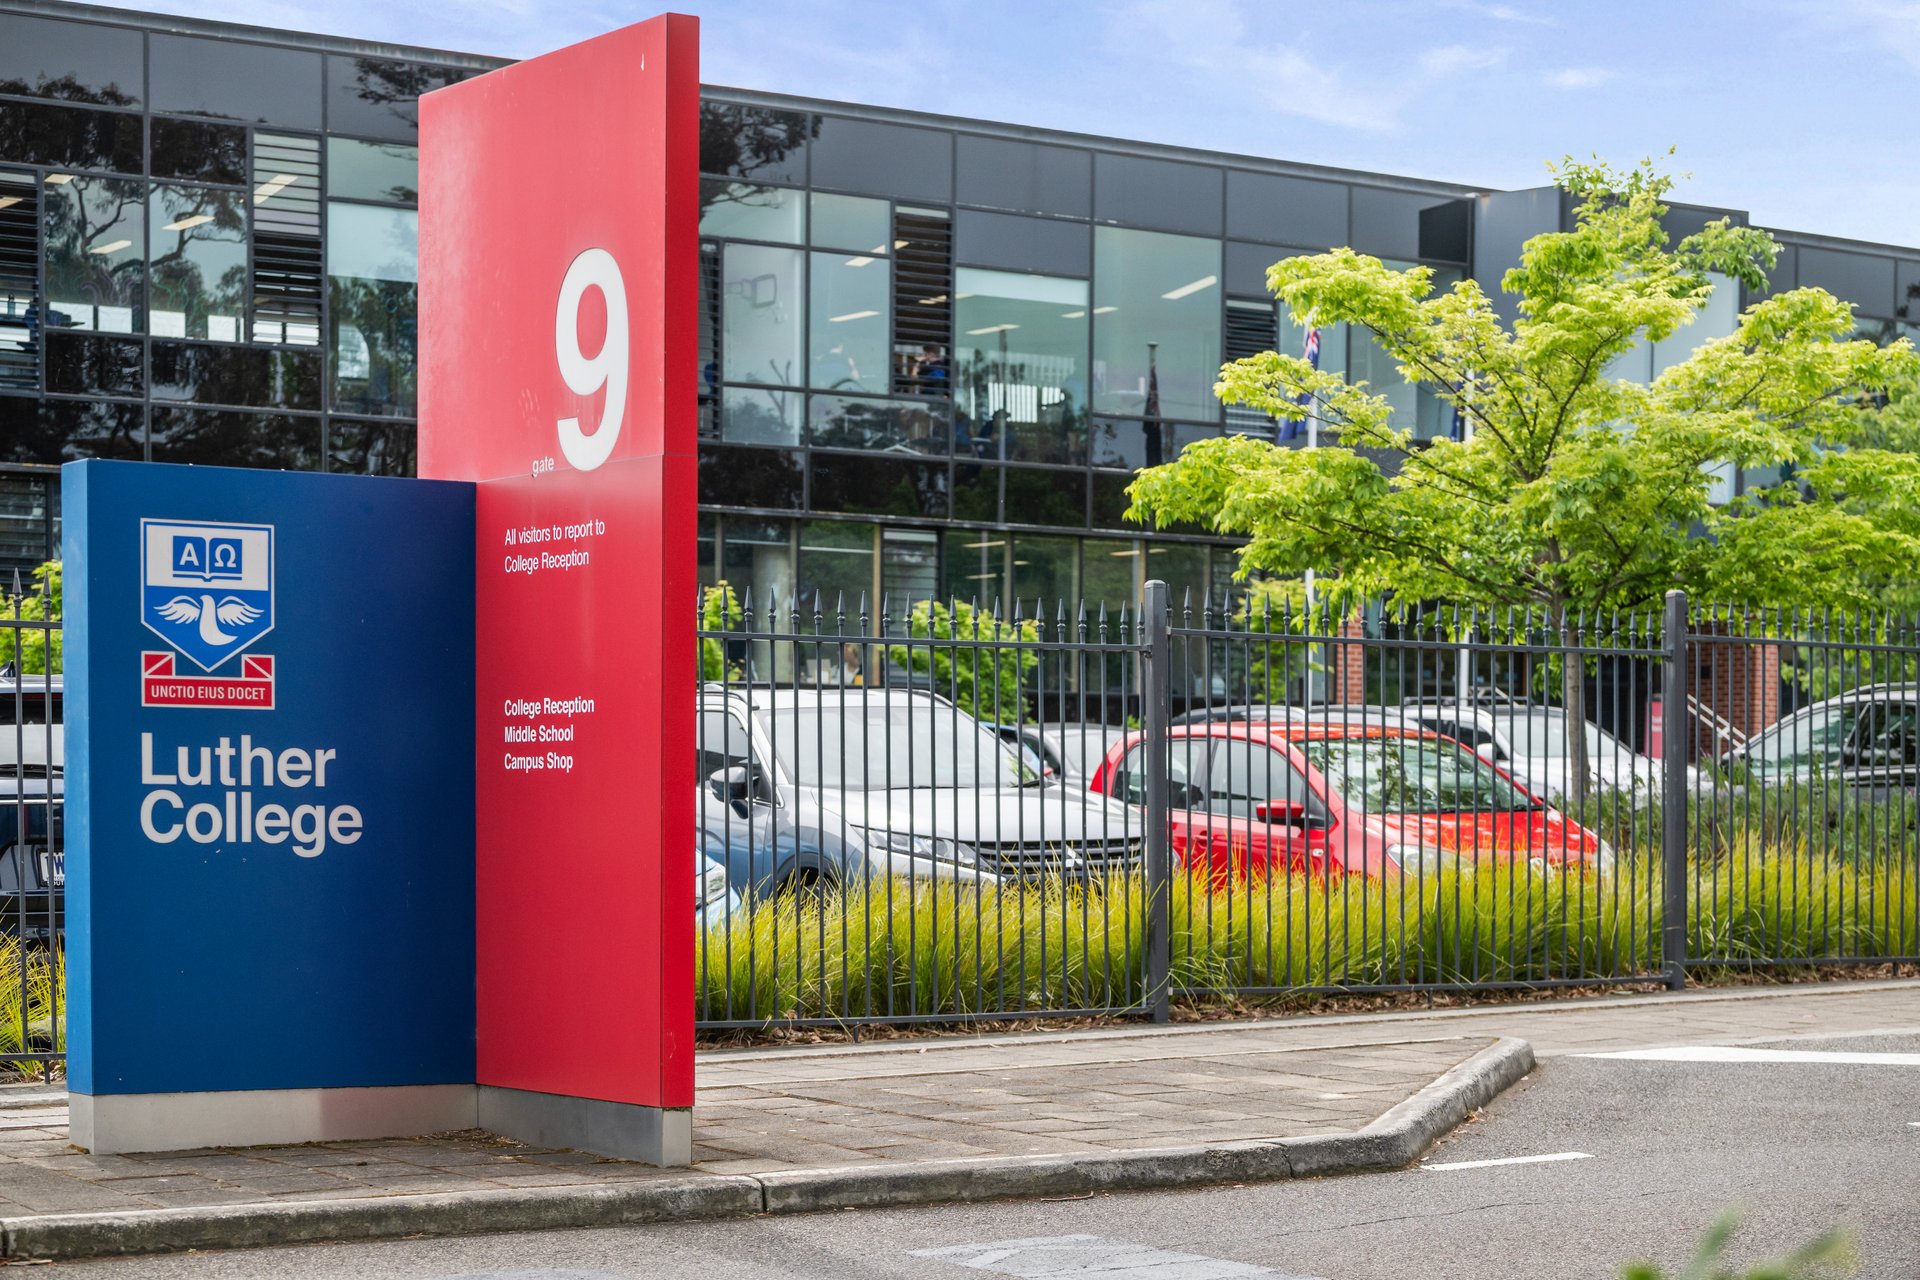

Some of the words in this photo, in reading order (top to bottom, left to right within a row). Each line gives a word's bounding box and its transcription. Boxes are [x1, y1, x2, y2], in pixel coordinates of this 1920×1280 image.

[555, 247, 629, 471] 9
[532, 456, 555, 477] gate
[504, 529, 516, 545] All
[518, 526, 550, 544] visitors
[552, 524, 562, 540] to
[564, 519, 593, 542] report
[595, 519, 605, 535] to
[504, 554, 539, 575] College
[541, 549, 589, 571] Reception
[151, 685, 195, 698] UNCTIO
[197, 686, 225, 699] EIUS
[227, 687, 265, 700] DOCET
[504, 698, 541, 719] College
[543, 696, 595, 718] Reception
[504, 725, 537, 742] Middle
[538, 724, 574, 742] School
[141, 732, 336, 787] Luther
[504, 752, 544, 773] Campus
[546, 751, 573, 773] Shop
[140, 789, 363, 858] College
